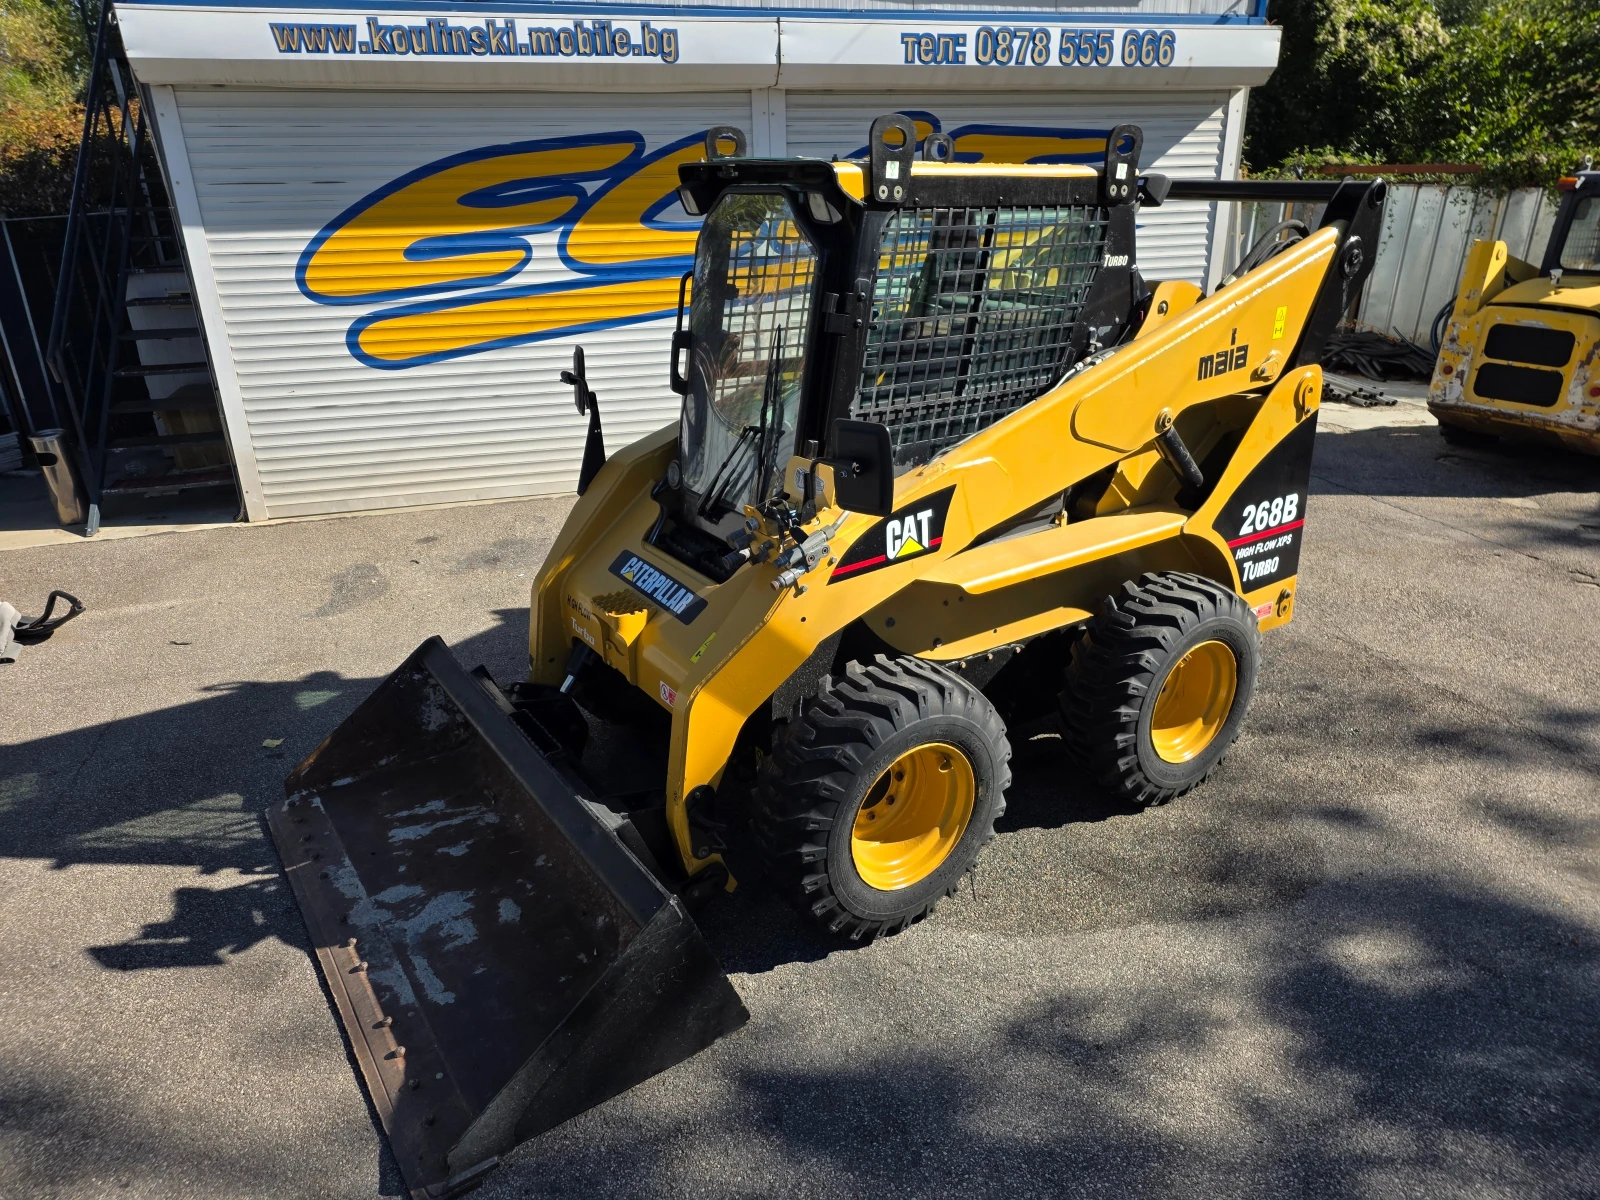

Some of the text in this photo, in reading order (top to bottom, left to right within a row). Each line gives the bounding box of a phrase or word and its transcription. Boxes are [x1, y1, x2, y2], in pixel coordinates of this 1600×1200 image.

[269, 17, 679, 64] www.koulinski.mobile.bg
[901, 26, 1176, 67] тел: 0878 555 666
[886, 508, 933, 560] CAT
[1239, 493, 1299, 536] 268B
[1235, 533, 1293, 560] HIGH FLOW XPS
[620, 556, 694, 615] CATERPILLAR
[1242, 556, 1280, 582] TURBO
[570, 616, 595, 646] Turbo
